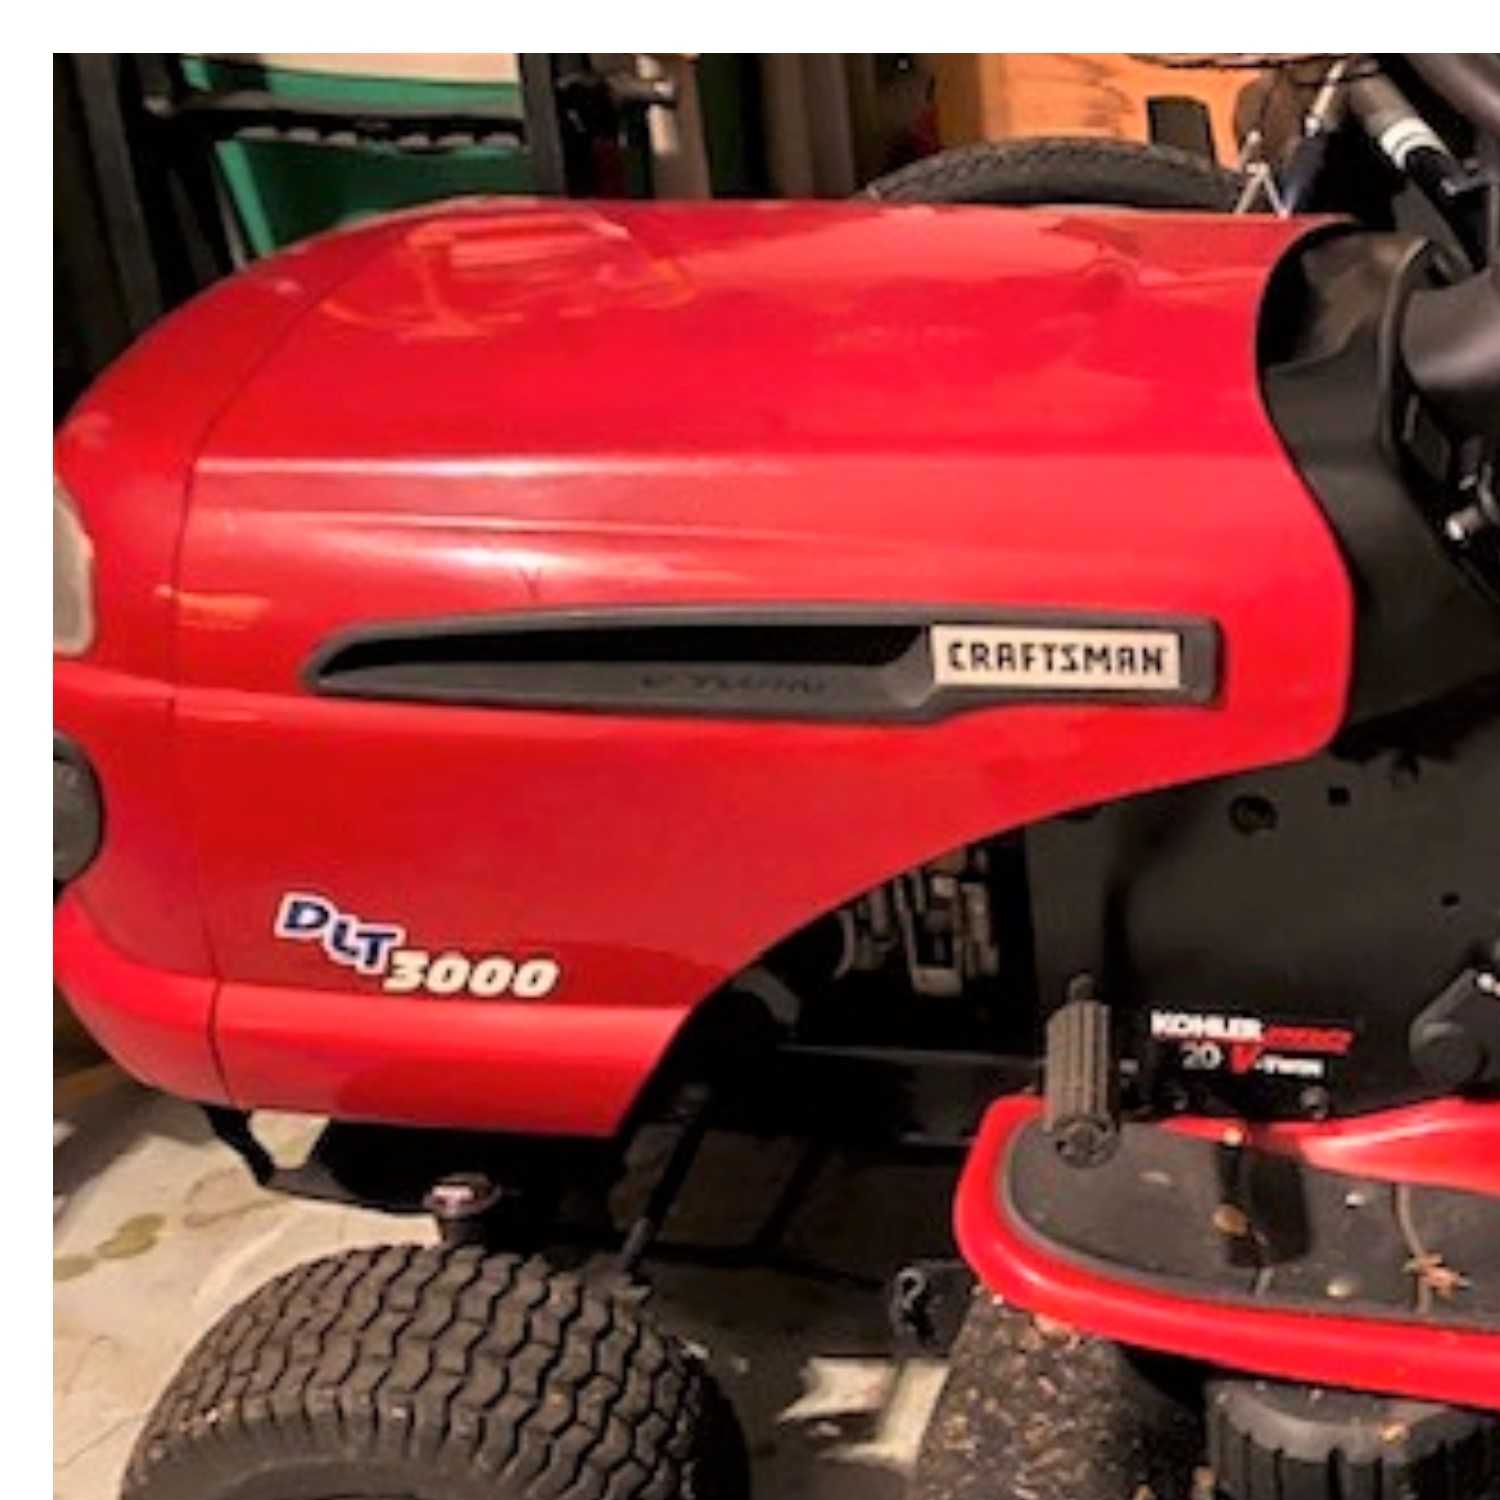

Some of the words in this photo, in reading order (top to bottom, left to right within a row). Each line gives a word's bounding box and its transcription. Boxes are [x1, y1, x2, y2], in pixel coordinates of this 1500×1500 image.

[947, 642, 1169, 675] CRAFTSMAN
[274, 891, 407, 974] DLT
[382, 950, 560, 998] 3000
[1150, 1010, 1263, 1042] KOHLER
[1181, 1041, 1224, 1070] 20
